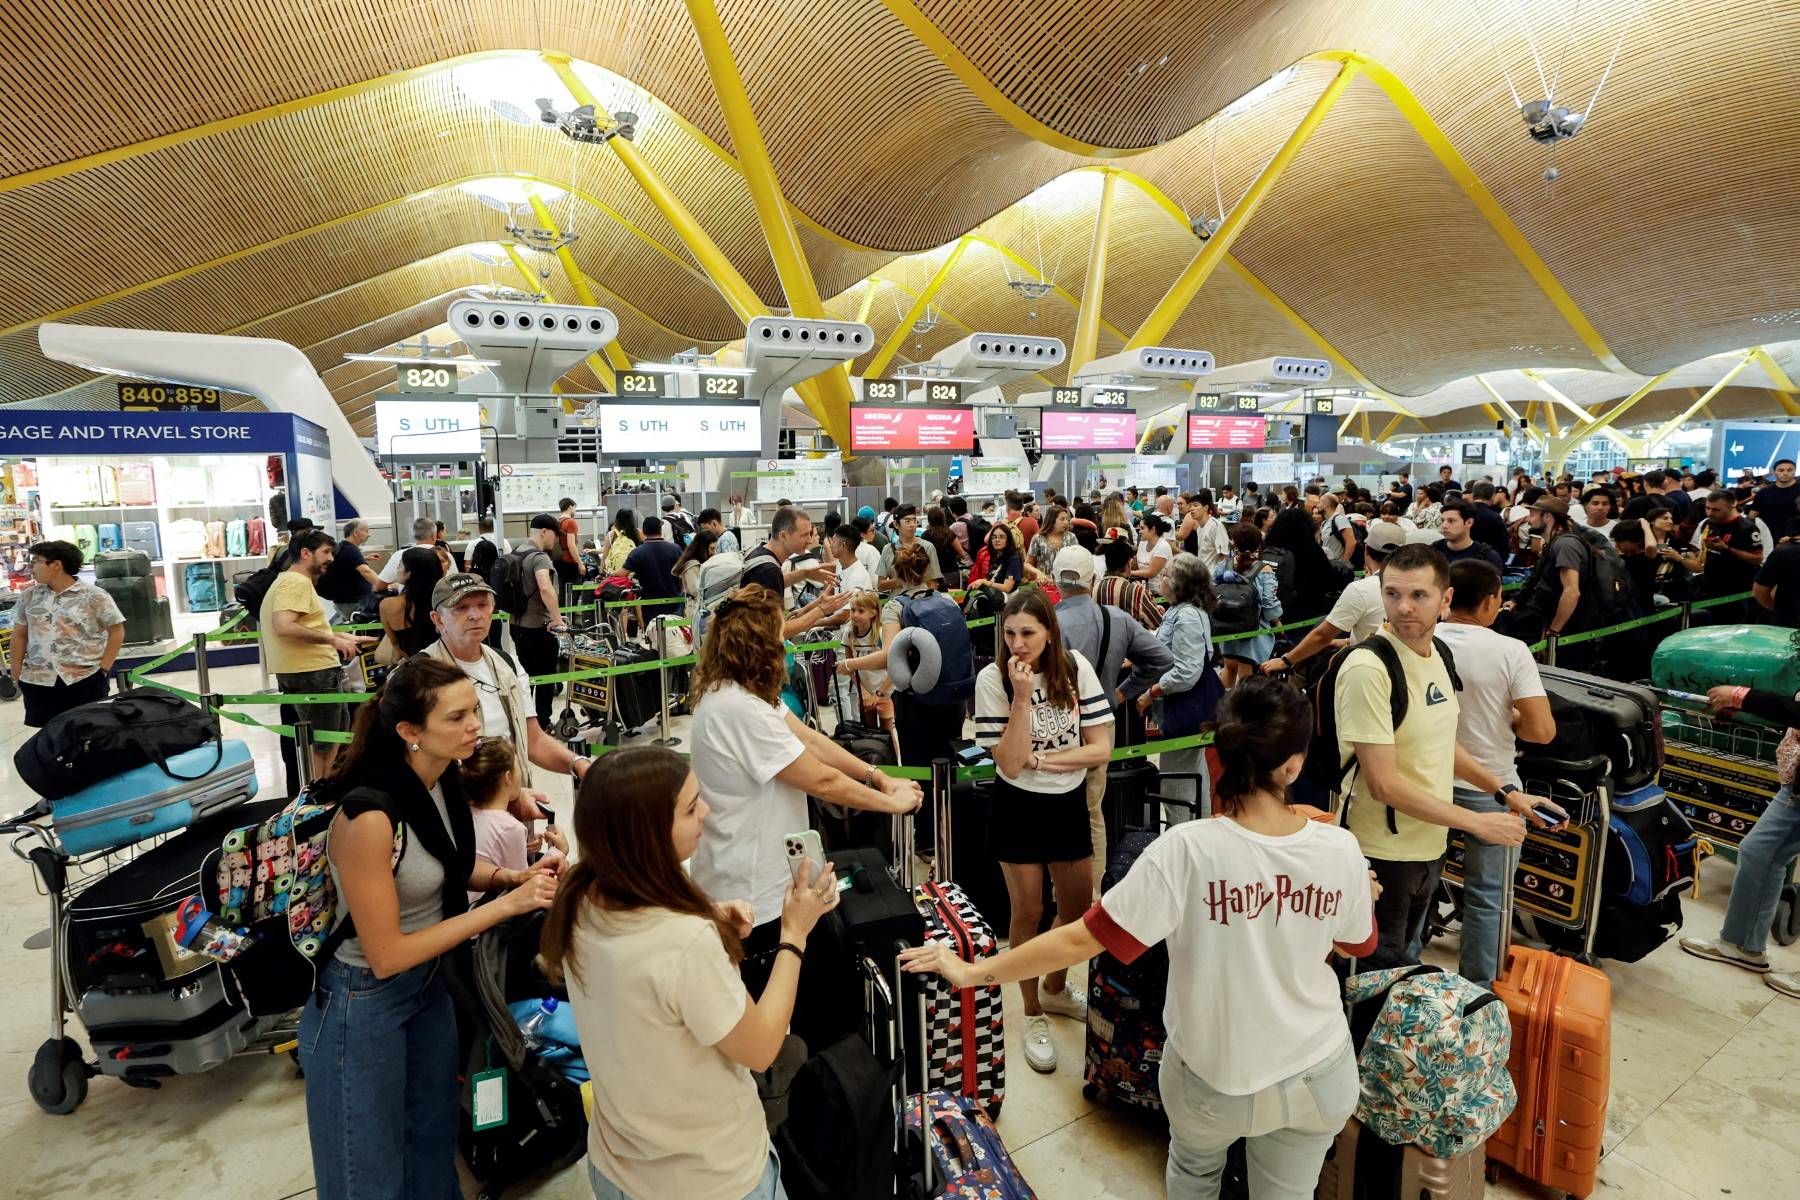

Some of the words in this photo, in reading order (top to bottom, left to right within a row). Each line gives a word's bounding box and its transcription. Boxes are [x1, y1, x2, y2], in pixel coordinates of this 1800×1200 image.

[406, 368, 450, 387] 820
[623, 375, 657, 392] 821
[706, 378, 738, 394] 822
[869, 383, 896, 398] 823
[932, 385, 957, 400] 824
[122, 387, 166, 403] 840
[175, 388, 217, 404] 859
[1056, 390, 1079, 404] 825
[1104, 392, 1125, 405] 826
[1200, 396, 1219, 408] 827
[1239, 397, 1257, 410] 828
[1317, 401, 1332, 412] 829
[58, 425, 105, 439] AND
[108, 426, 187, 439] TRAVEL
[190, 426, 252, 439] STORE
[1202, 879, 1275, 926] Harry
[1275, 874, 1343, 928] Potter
